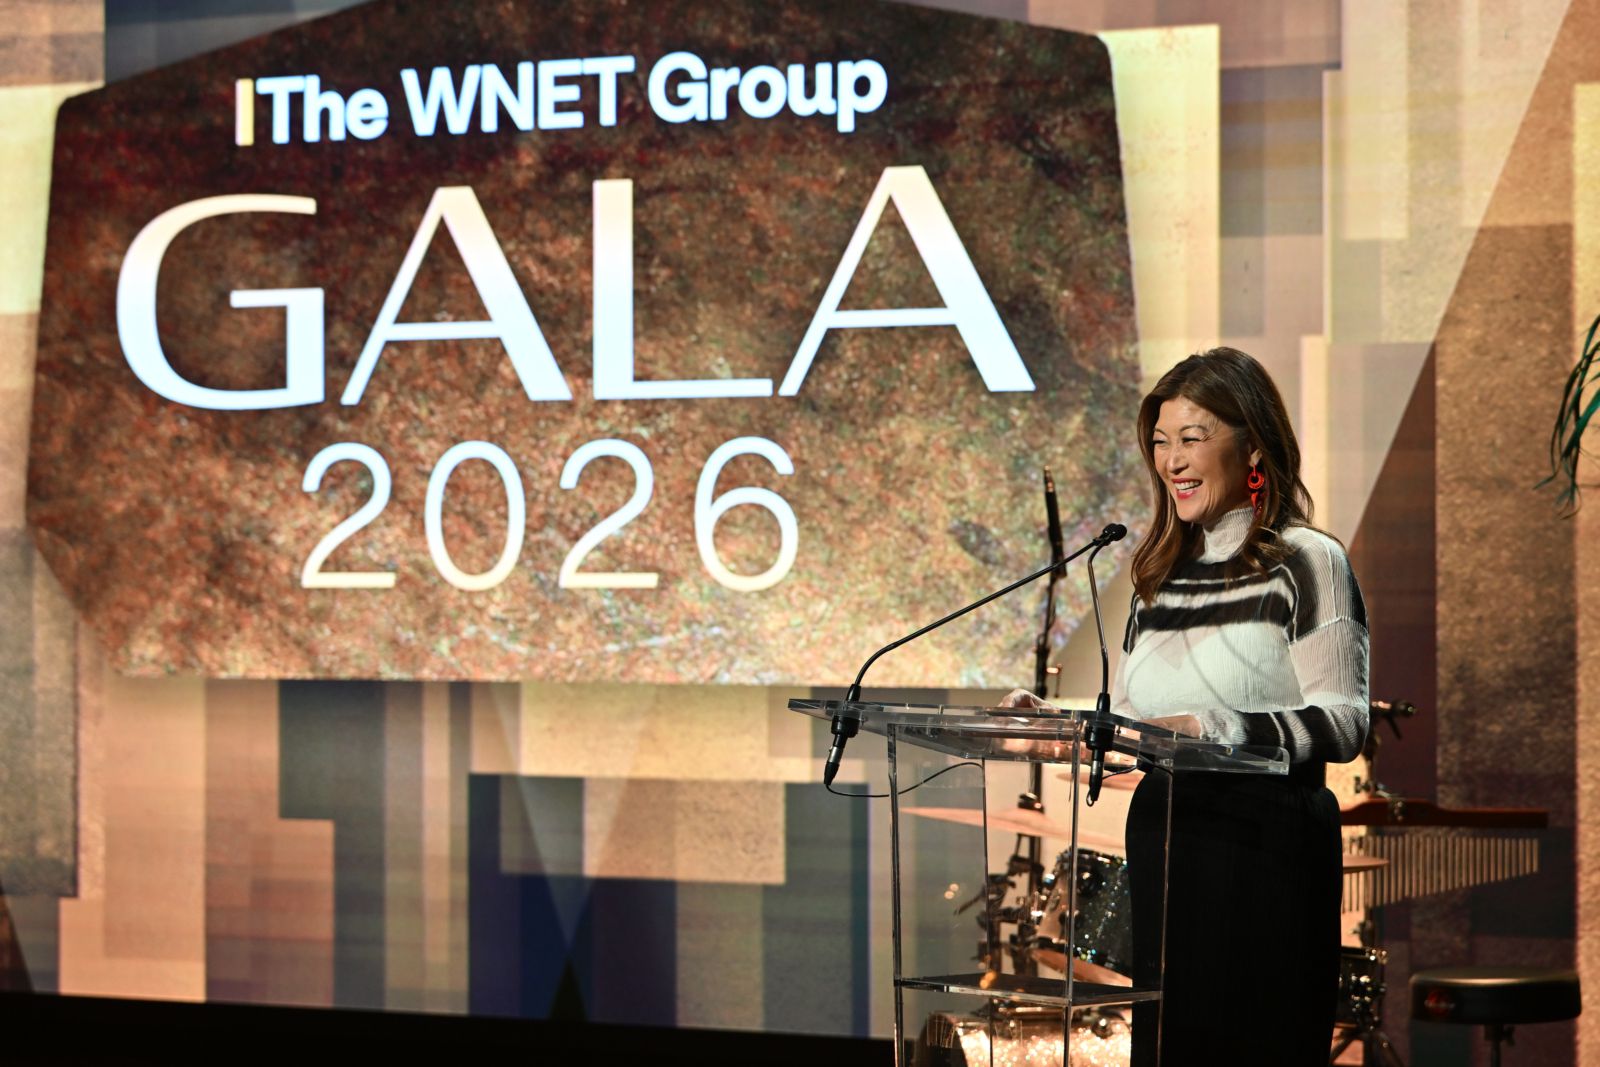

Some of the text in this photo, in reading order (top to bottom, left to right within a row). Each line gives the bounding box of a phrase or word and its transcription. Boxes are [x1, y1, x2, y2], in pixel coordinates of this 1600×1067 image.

[256, 51, 888, 144] The WNET Group
[116, 165, 1036, 410] GALA
[300, 435, 799, 593] 2026
